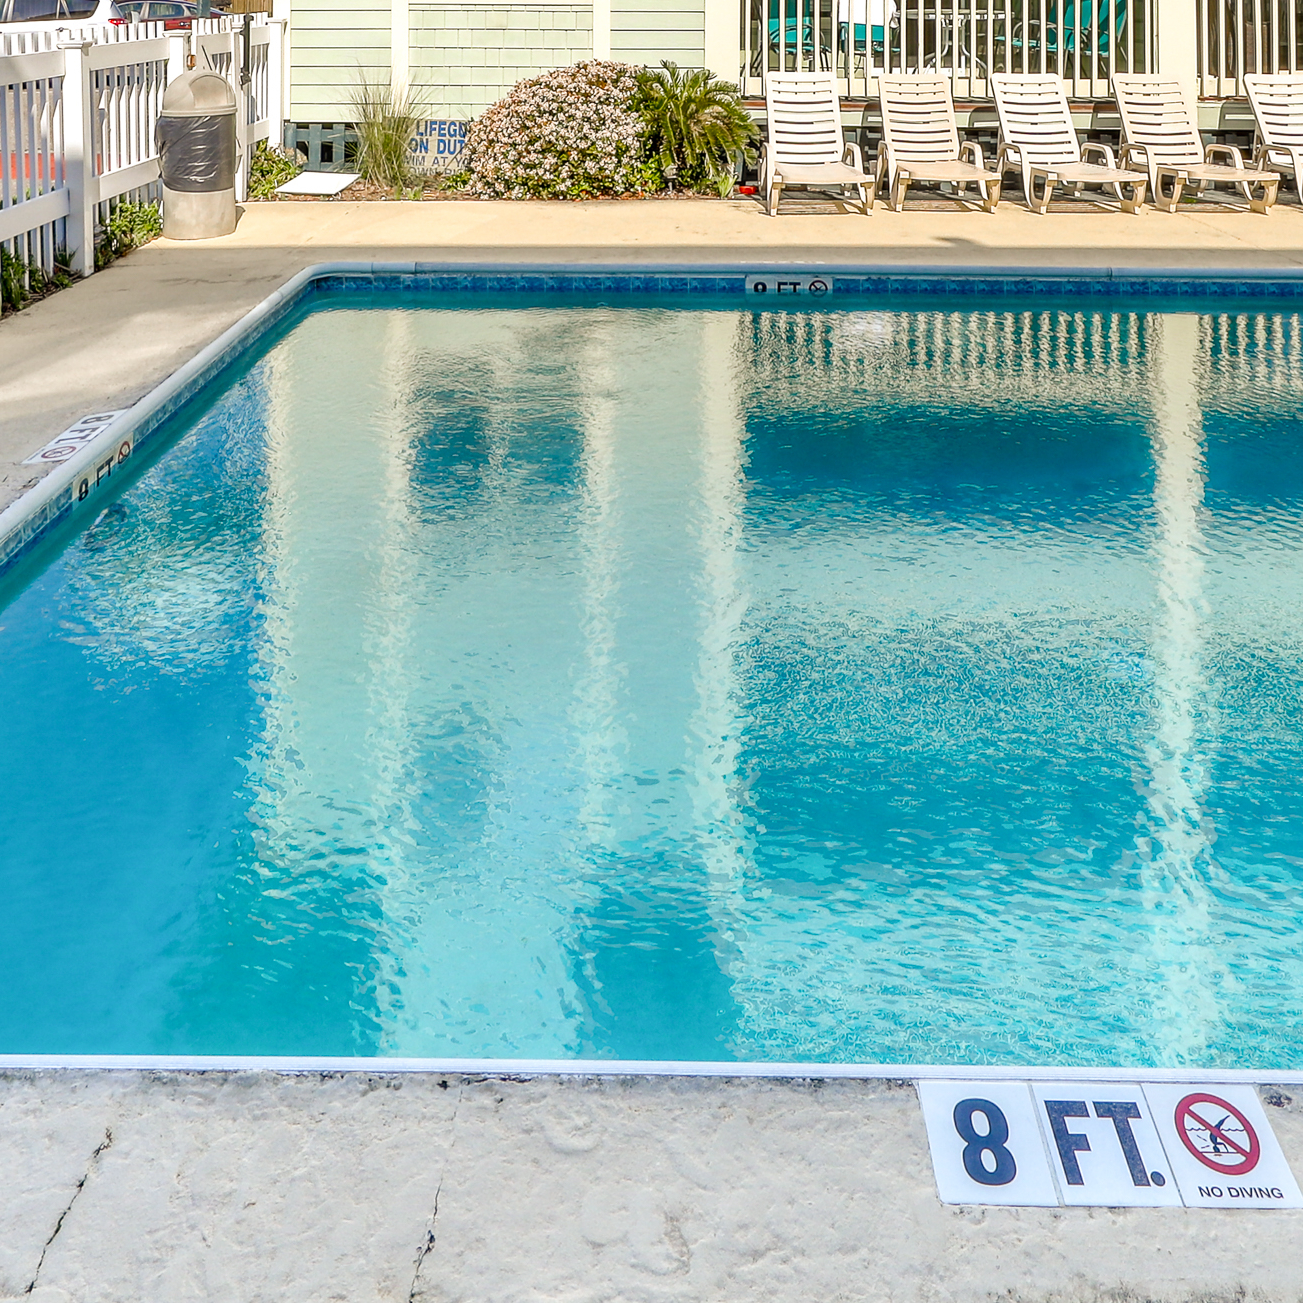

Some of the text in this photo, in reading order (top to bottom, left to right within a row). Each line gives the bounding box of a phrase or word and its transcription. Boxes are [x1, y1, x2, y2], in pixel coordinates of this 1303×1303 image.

[409, 138, 429, 153] ON
[432, 156, 448, 167] AT
[78, 477, 89, 502] 8
[953, 1098, 1166, 1187] 8 FT.
[1198, 1186, 1284, 1199] NO DIVING
